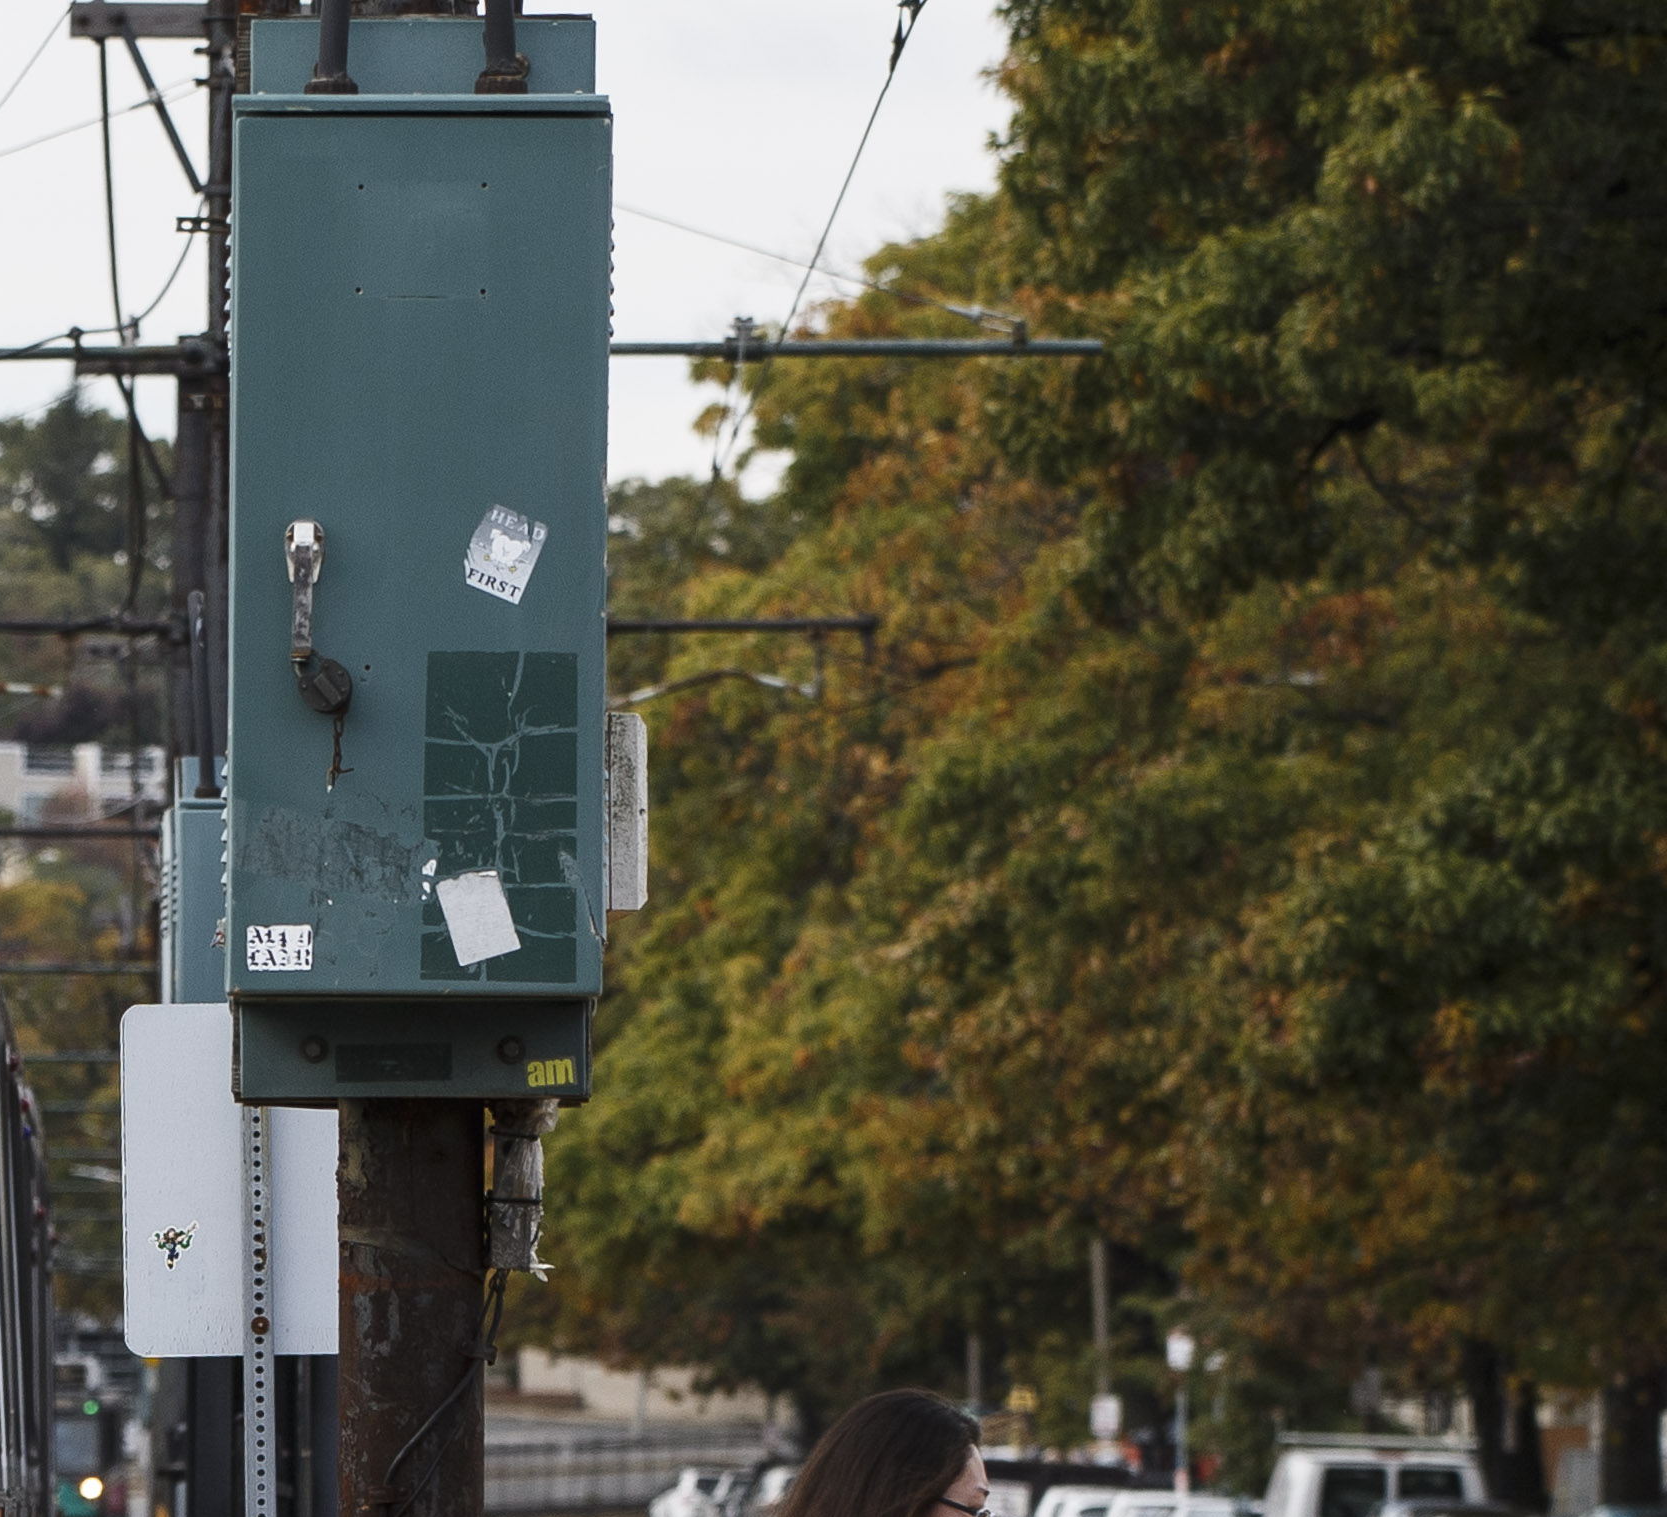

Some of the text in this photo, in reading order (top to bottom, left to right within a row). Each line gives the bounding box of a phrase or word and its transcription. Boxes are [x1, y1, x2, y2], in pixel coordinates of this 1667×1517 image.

[491, 509, 545, 541] HEAD
[467, 567, 521, 598] FIRST
[526, 1057, 575, 1088] am
